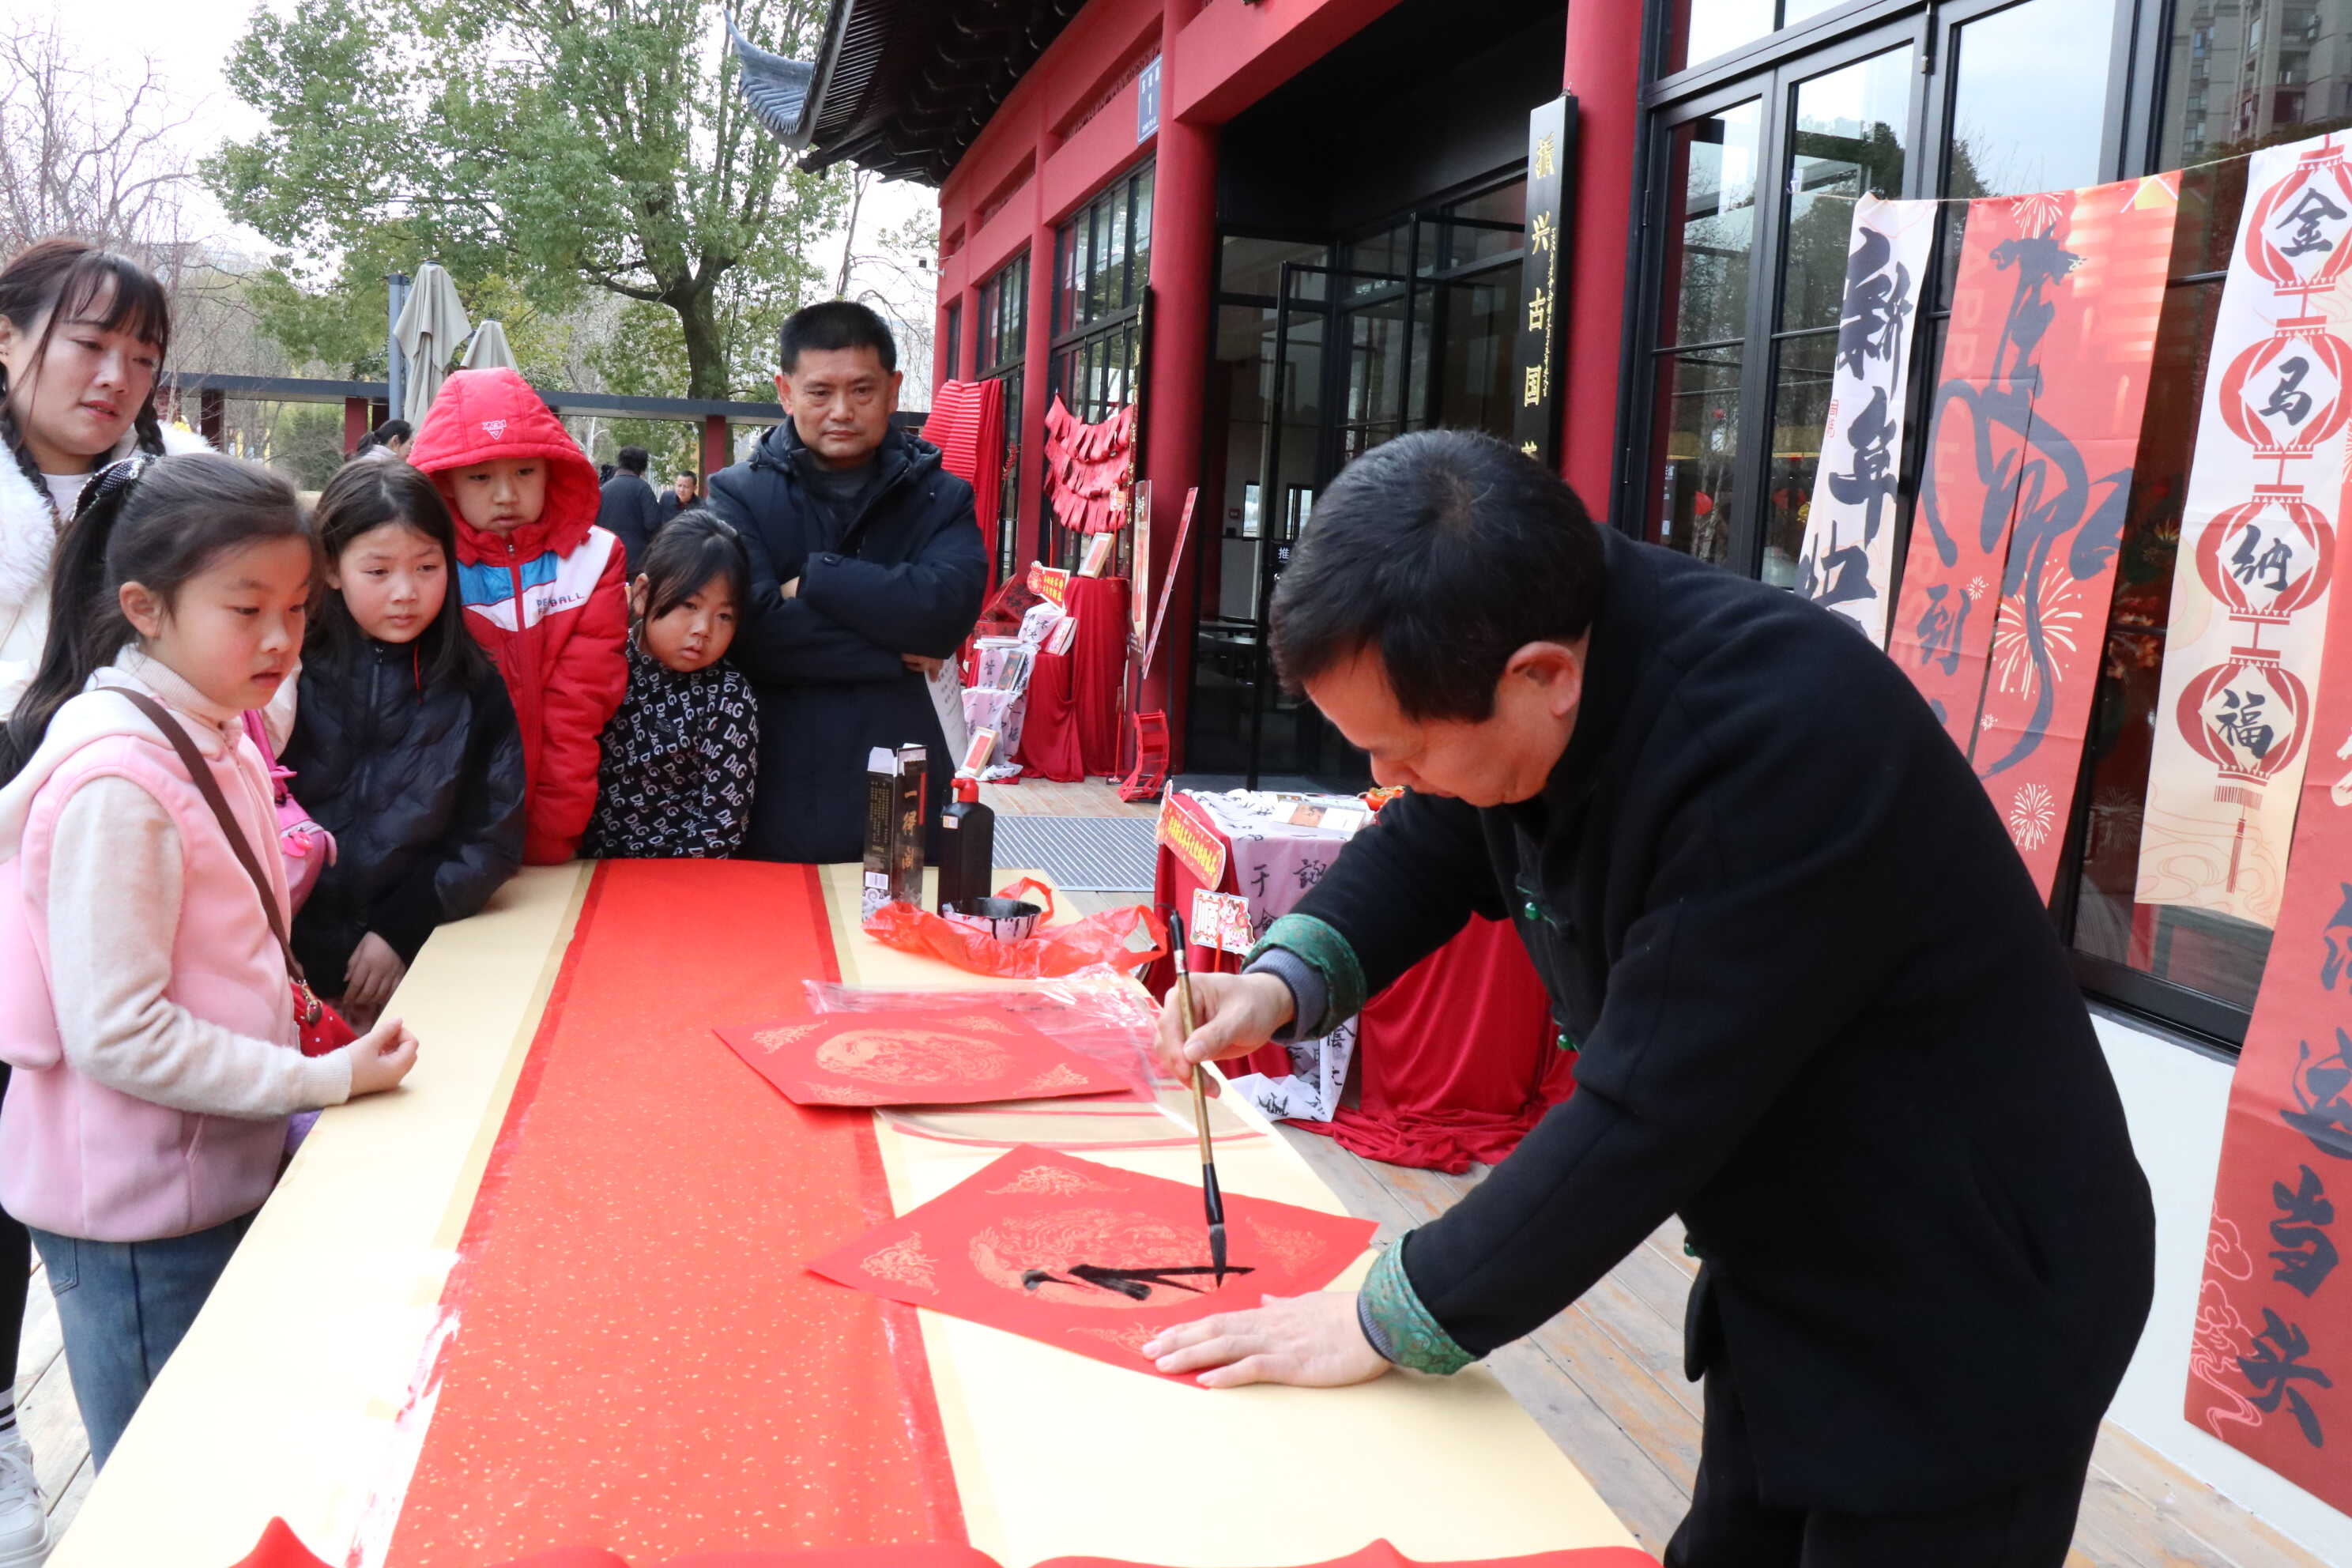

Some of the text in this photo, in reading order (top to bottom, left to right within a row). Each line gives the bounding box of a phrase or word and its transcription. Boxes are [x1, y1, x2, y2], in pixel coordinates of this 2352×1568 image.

[1278, 547, 1290, 560] 推
[679, 691, 695, 721] D&G
[631, 711, 645, 741] D&G
[723, 722, 748, 748] D&G
[699, 738, 723, 759] D&G
[722, 753, 747, 779] D&G
[721, 782, 744, 805] D&G
[624, 813, 650, 836] D&G
